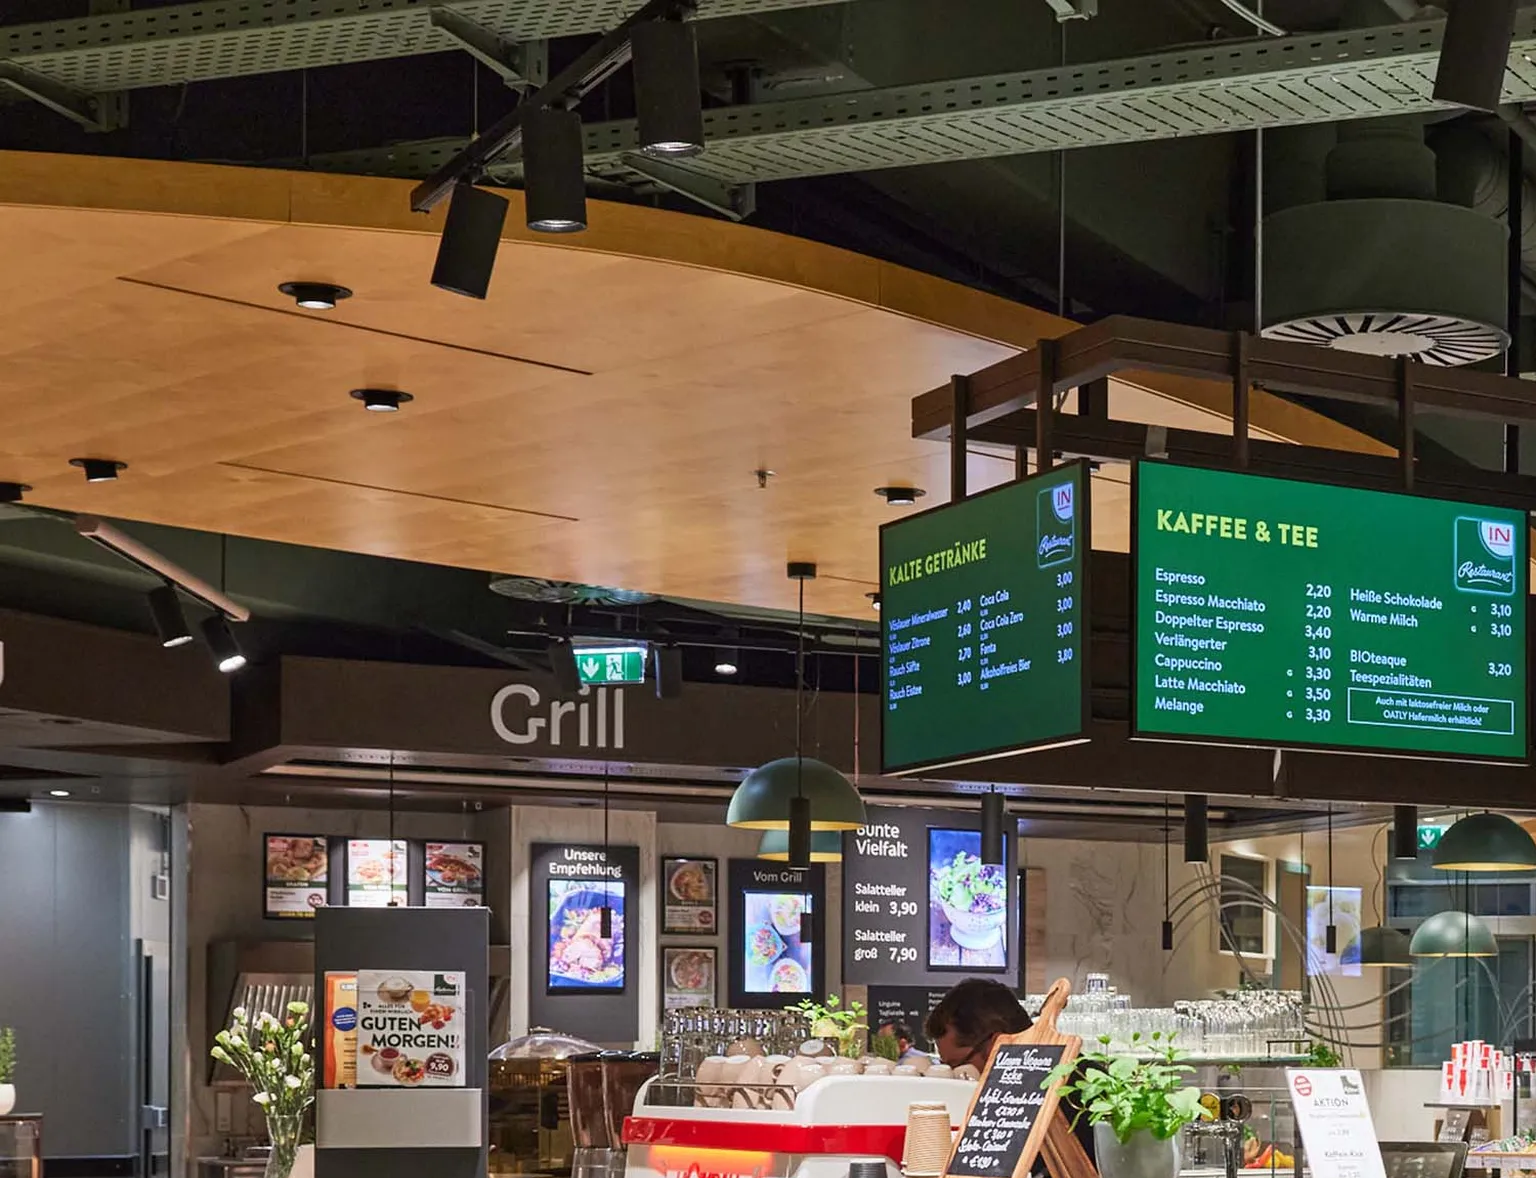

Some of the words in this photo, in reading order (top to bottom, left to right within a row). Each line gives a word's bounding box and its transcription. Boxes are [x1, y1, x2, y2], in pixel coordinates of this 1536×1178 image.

[1057, 488, 1071, 507] IN
[1157, 509, 1247, 540] KAFFEE
[1255, 520, 1271, 543] &
[1277, 522, 1319, 548] TEE
[1488, 526, 1510, 543] IN
[889, 558, 923, 587] KALTE
[925, 538, 986, 576] GETRÄNKE
[1057, 571, 1073, 587] 3,00
[1155, 567, 1205, 585] Espresso
[1458, 561, 1514, 582] Restaurant
[1305, 583, 1332, 599] 2,20
[1350, 588, 1382, 603] Heiße
[1384, 591, 1443, 610] Schokolade
[980, 594, 995, 607] Coca
[1057, 596, 1073, 612] 3,00
[1155, 589, 1205, 607] Espresso
[1207, 594, 1266, 612] Macchiato
[1305, 604, 1332, 620] 2,20
[1350, 608, 1387, 625] Warme
[1389, 612, 1418, 628] Milch
[1490, 603, 1512, 618] 3,10
[980, 619, 995, 631] Coca
[1057, 621, 1073, 638] 3,00
[1155, 610, 1213, 629] Doppelter
[1215, 616, 1265, 633] Espresso
[1304, 625, 1332, 640] 3,40
[1490, 623, 1512, 638] 3,10
[1154, 631, 1227, 651] Verlängerter
[1308, 646, 1331, 661] 3,10
[1350, 649, 1407, 668] BIOteaque
[1154, 653, 1222, 671] Cappuccino
[1488, 662, 1512, 677] 3,20
[1305, 666, 1331, 681] 3,30
[1349, 669, 1432, 688] Teespezialitäten
[1155, 674, 1185, 690] Latte
[1187, 677, 1246, 694] Macchiato
[1305, 687, 1331, 702] 3,50
[1154, 696, 1204, 715] Melange
[1375, 696, 1394, 706] Auch
[1395, 698, 1408, 707] mit
[1452, 702, 1472, 713] Milch
[1472, 704, 1489, 714] oder
[490, 683, 624, 748] Grill
[1305, 708, 1331, 723] 3,30
[1383, 709, 1408, 721] OATLY
[564, 848, 607, 862] Unsere
[856, 839, 908, 857] Vielfalt
[549, 862, 622, 878] Empfehlung
[753, 871, 778, 882] Vom
[780, 871, 802, 883] Grill
[855, 883, 907, 896] Salatteller
[855, 900, 880, 913] klein
[889, 901, 918, 917] 3,90
[854, 929, 906, 943] Salatteller
[854, 948, 878, 961] groß
[889, 947, 918, 963] 7,90
[361, 1016, 422, 1031] GUTEN
[371, 1034, 455, 1048] MORGEN!
[1313, 1098, 1349, 1107] AKTION
